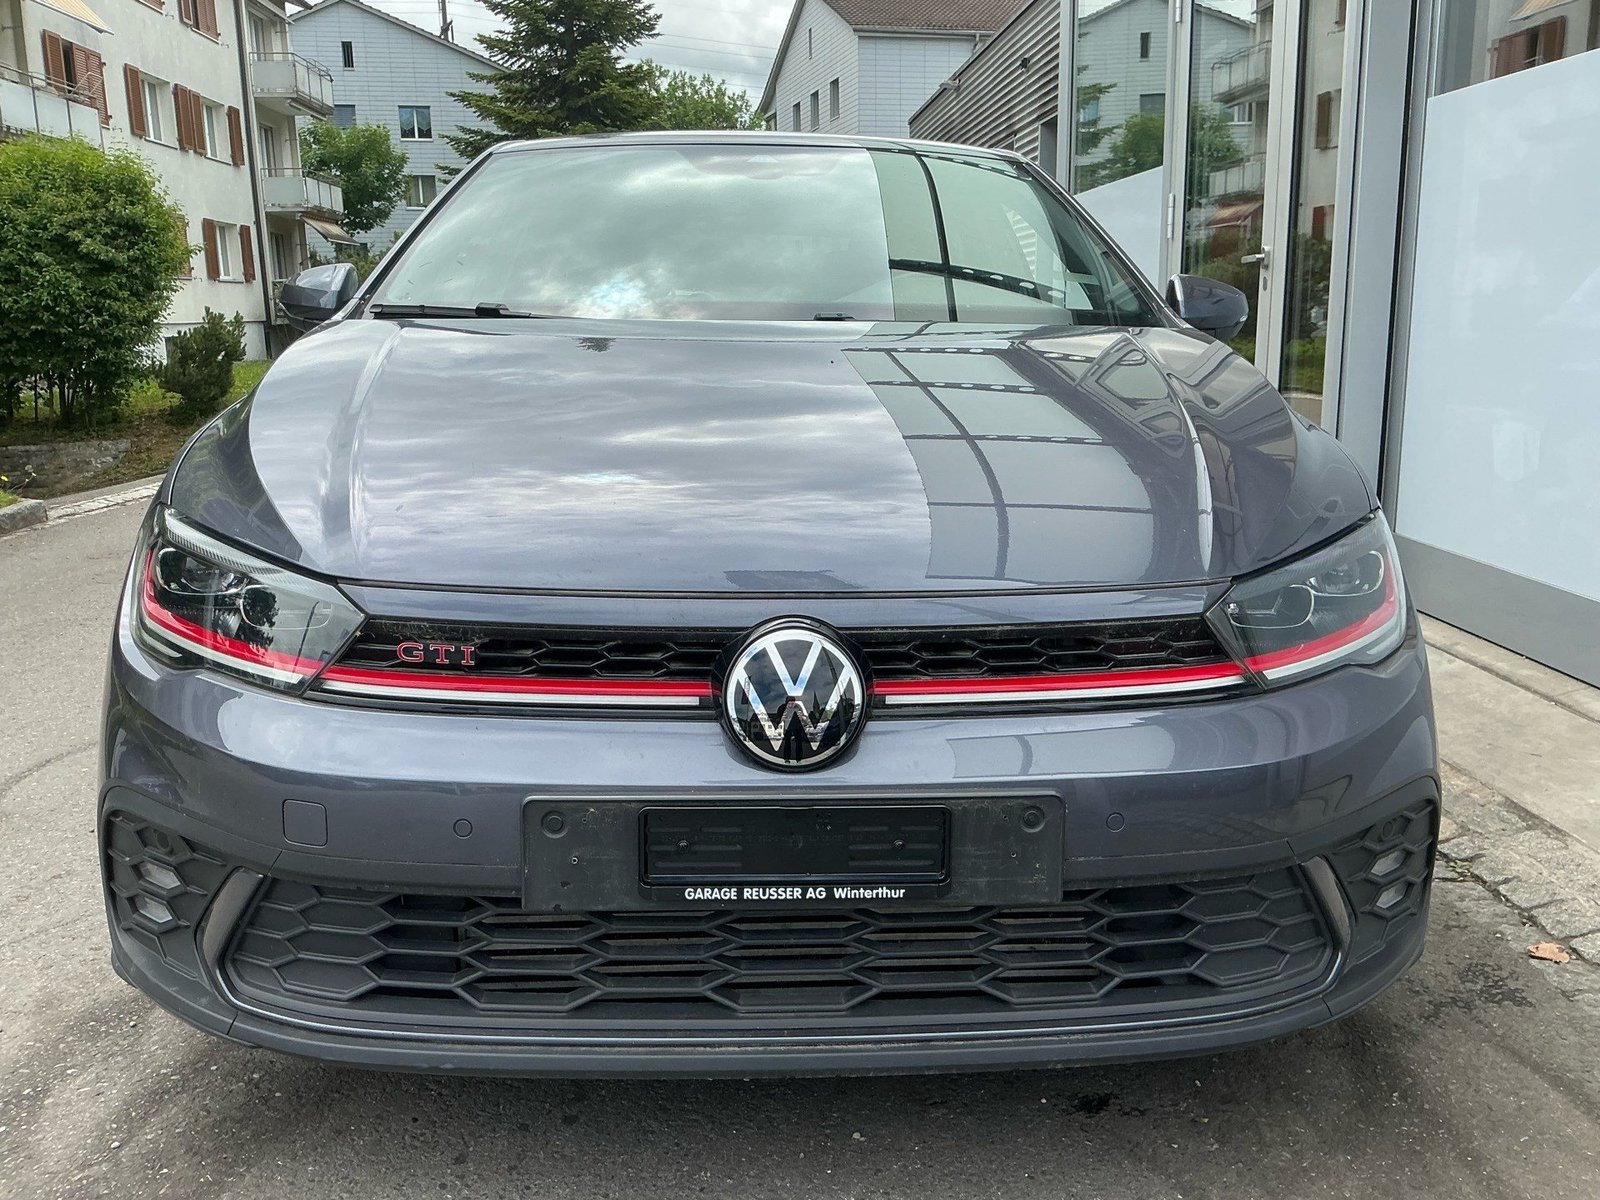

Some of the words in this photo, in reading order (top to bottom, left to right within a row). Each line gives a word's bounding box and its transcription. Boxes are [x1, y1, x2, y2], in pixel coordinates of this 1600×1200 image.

[396, 641, 476, 665] GTI
[684, 887, 738, 900] GARAGE
[743, 887, 802, 900] REUSSER
[805, 887, 827, 899] AG
[833, 886, 906, 899] Winterthur
